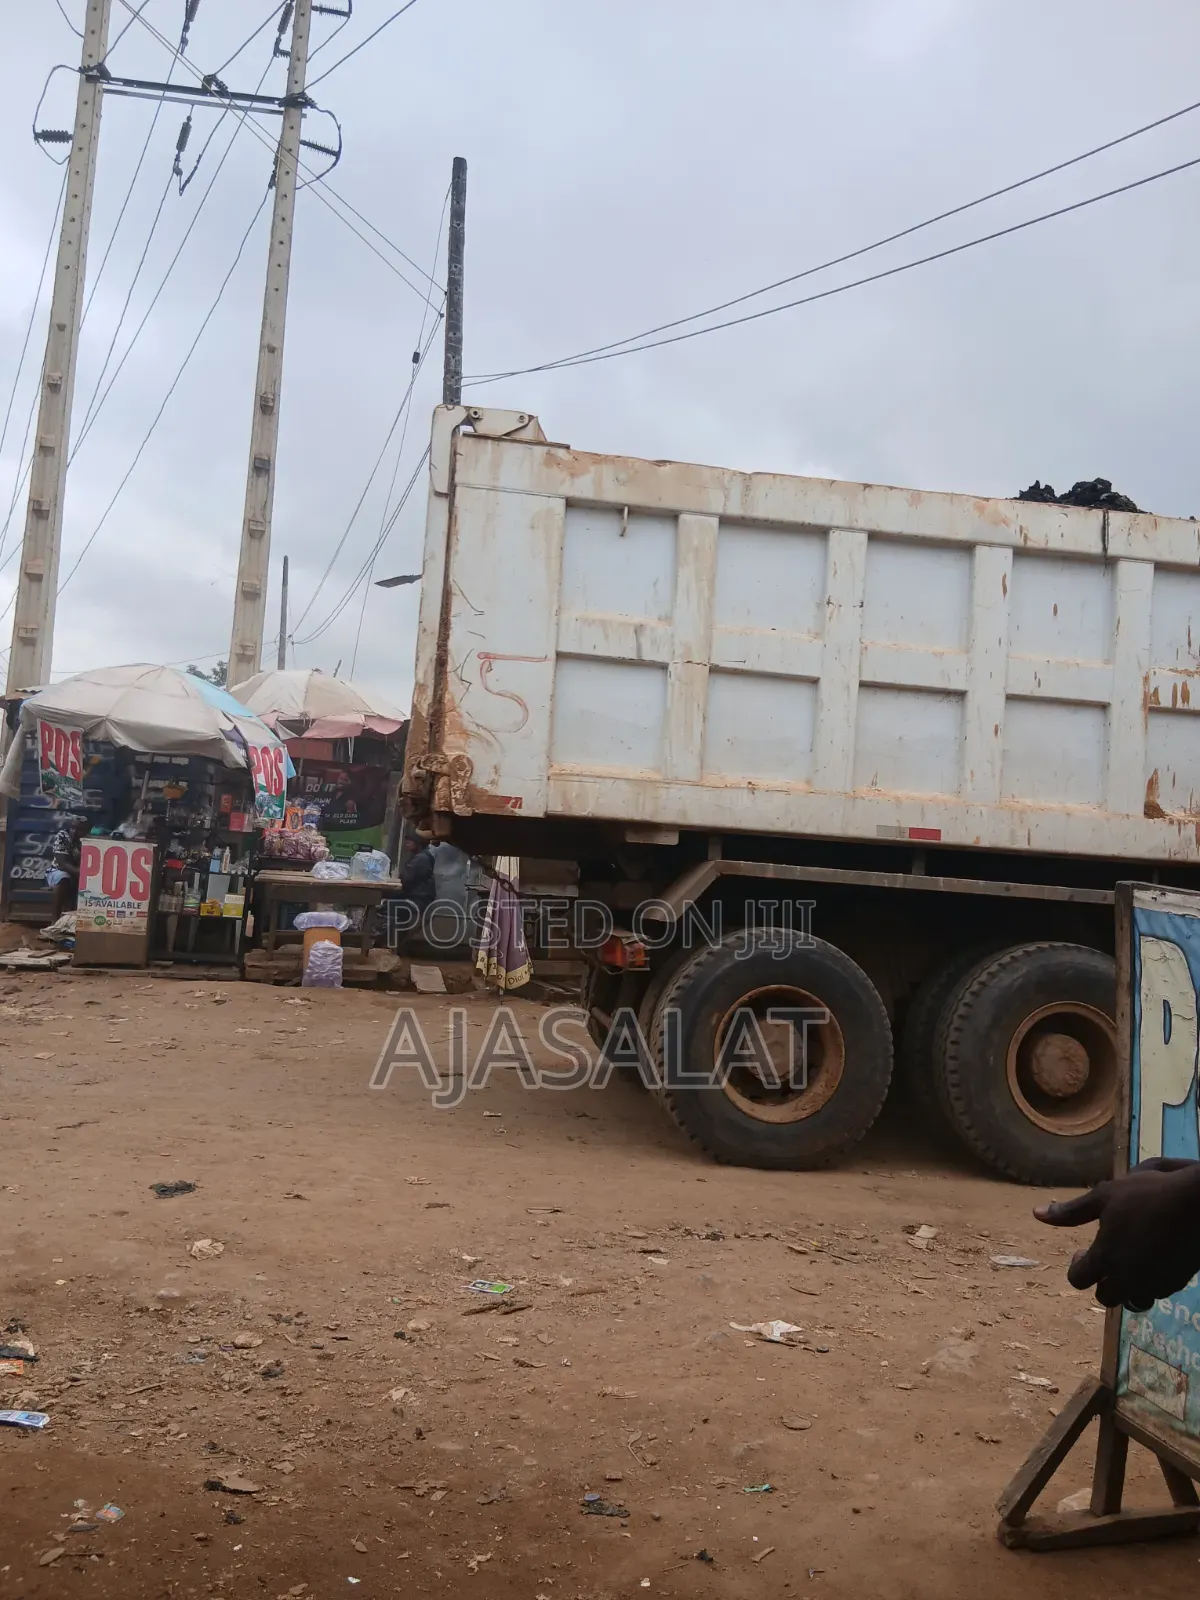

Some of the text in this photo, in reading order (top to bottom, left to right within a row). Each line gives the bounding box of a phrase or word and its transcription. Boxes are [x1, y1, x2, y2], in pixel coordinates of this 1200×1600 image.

[40, 721, 83, 782] POS
[248, 745, 284, 797] POS
[79, 845, 153, 901] POS
[85, 899, 142, 909] IS AVAILABLE
